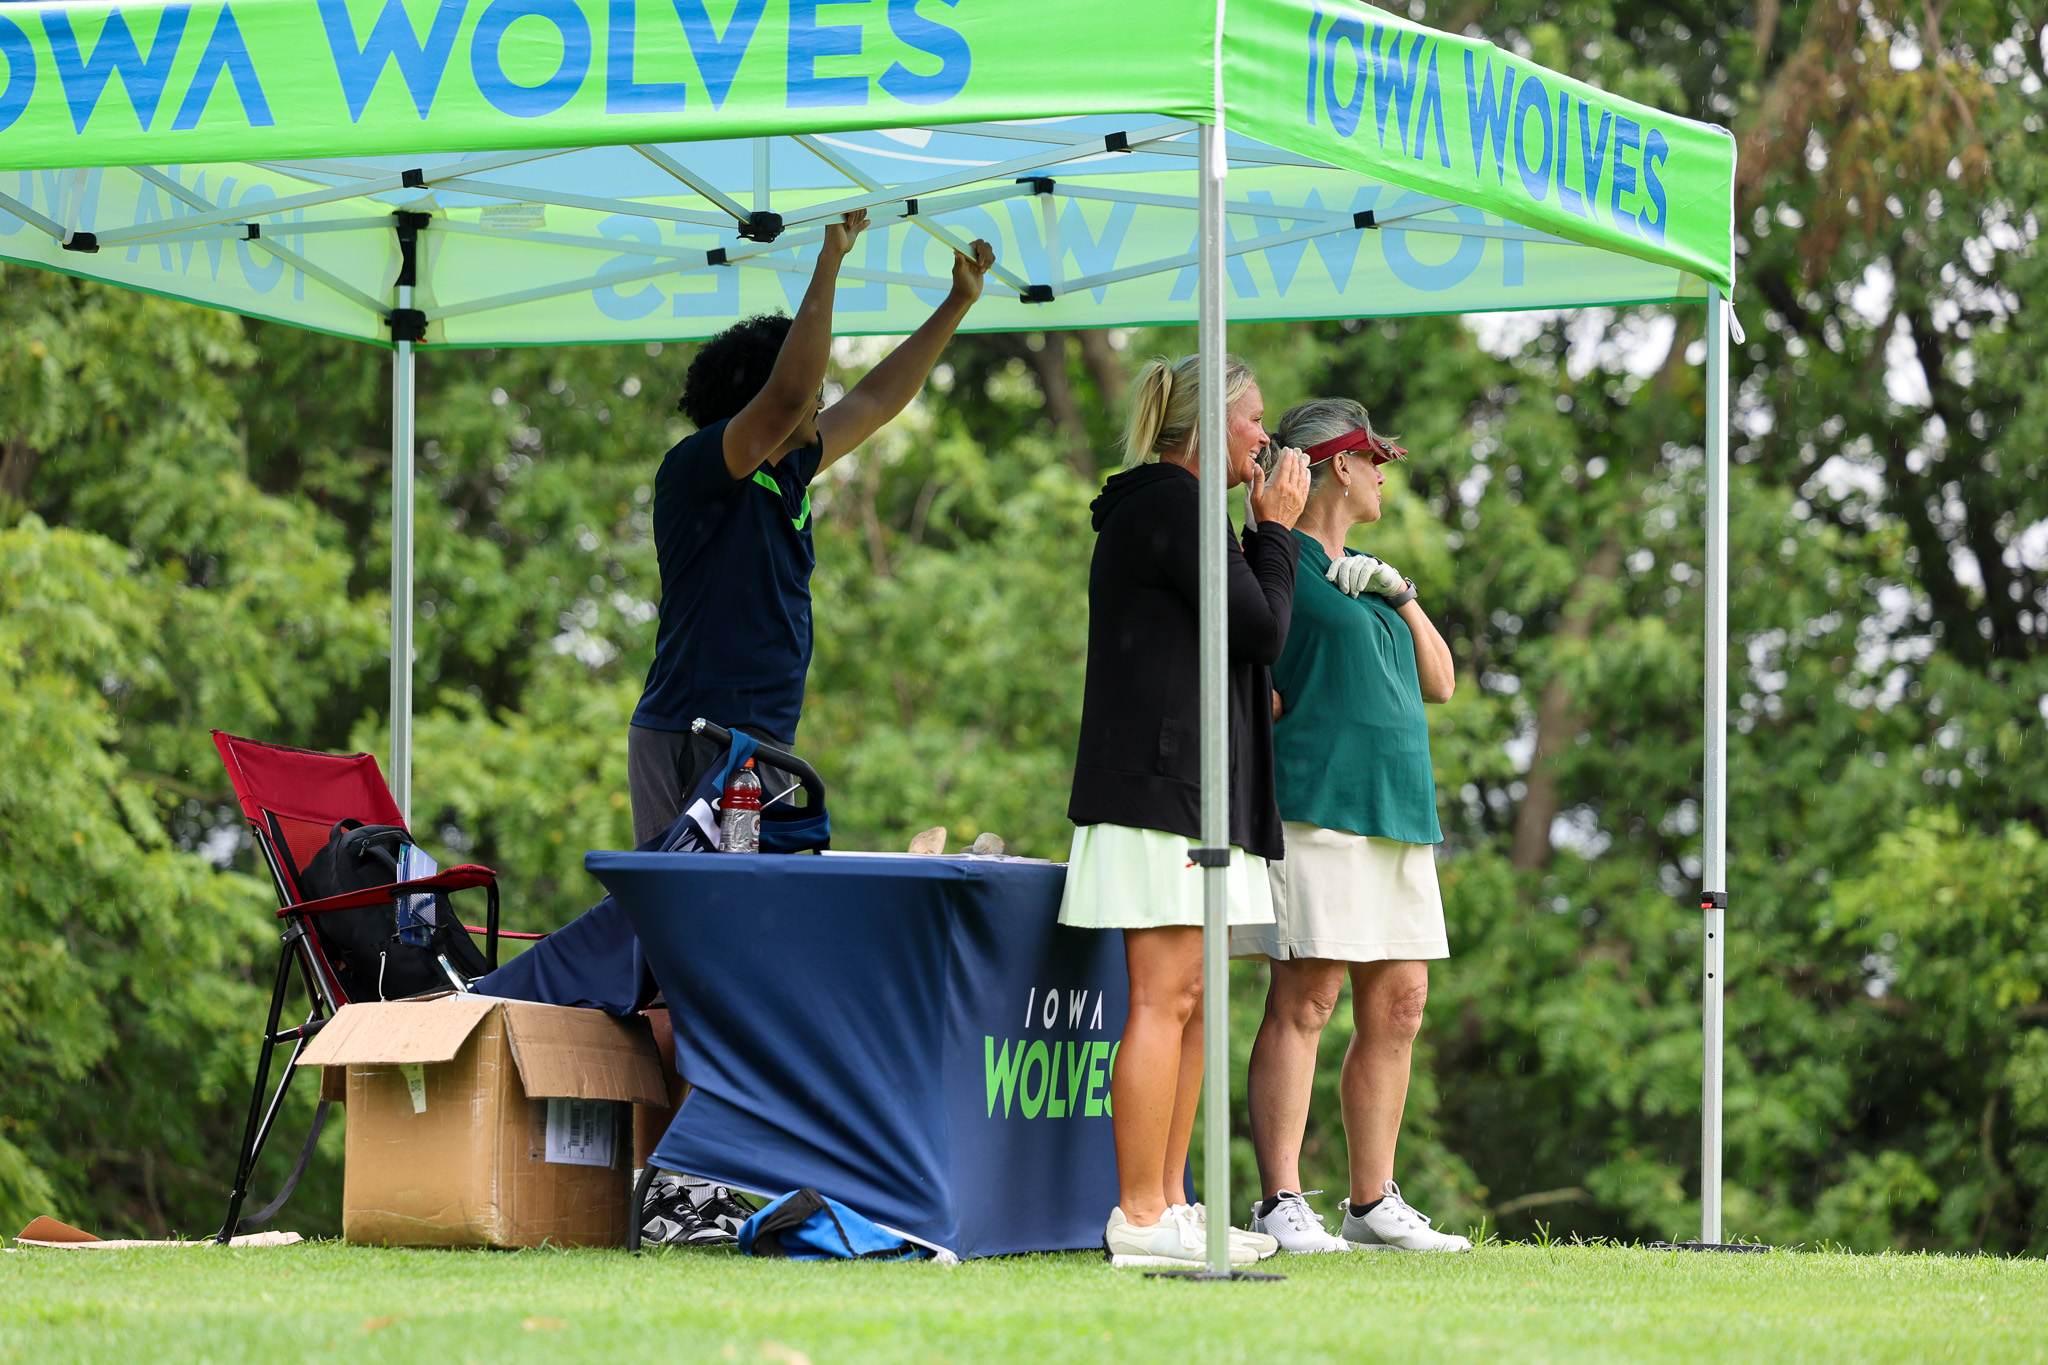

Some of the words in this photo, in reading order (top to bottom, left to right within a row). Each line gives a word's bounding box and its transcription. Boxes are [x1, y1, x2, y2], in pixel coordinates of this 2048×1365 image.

[317, 0, 972, 124] WOLVES
[1306, 0, 1451, 168] IOWA
[1464, 48, 1669, 247] WOLVES
[1025, 987, 1103, 1030] IOWA
